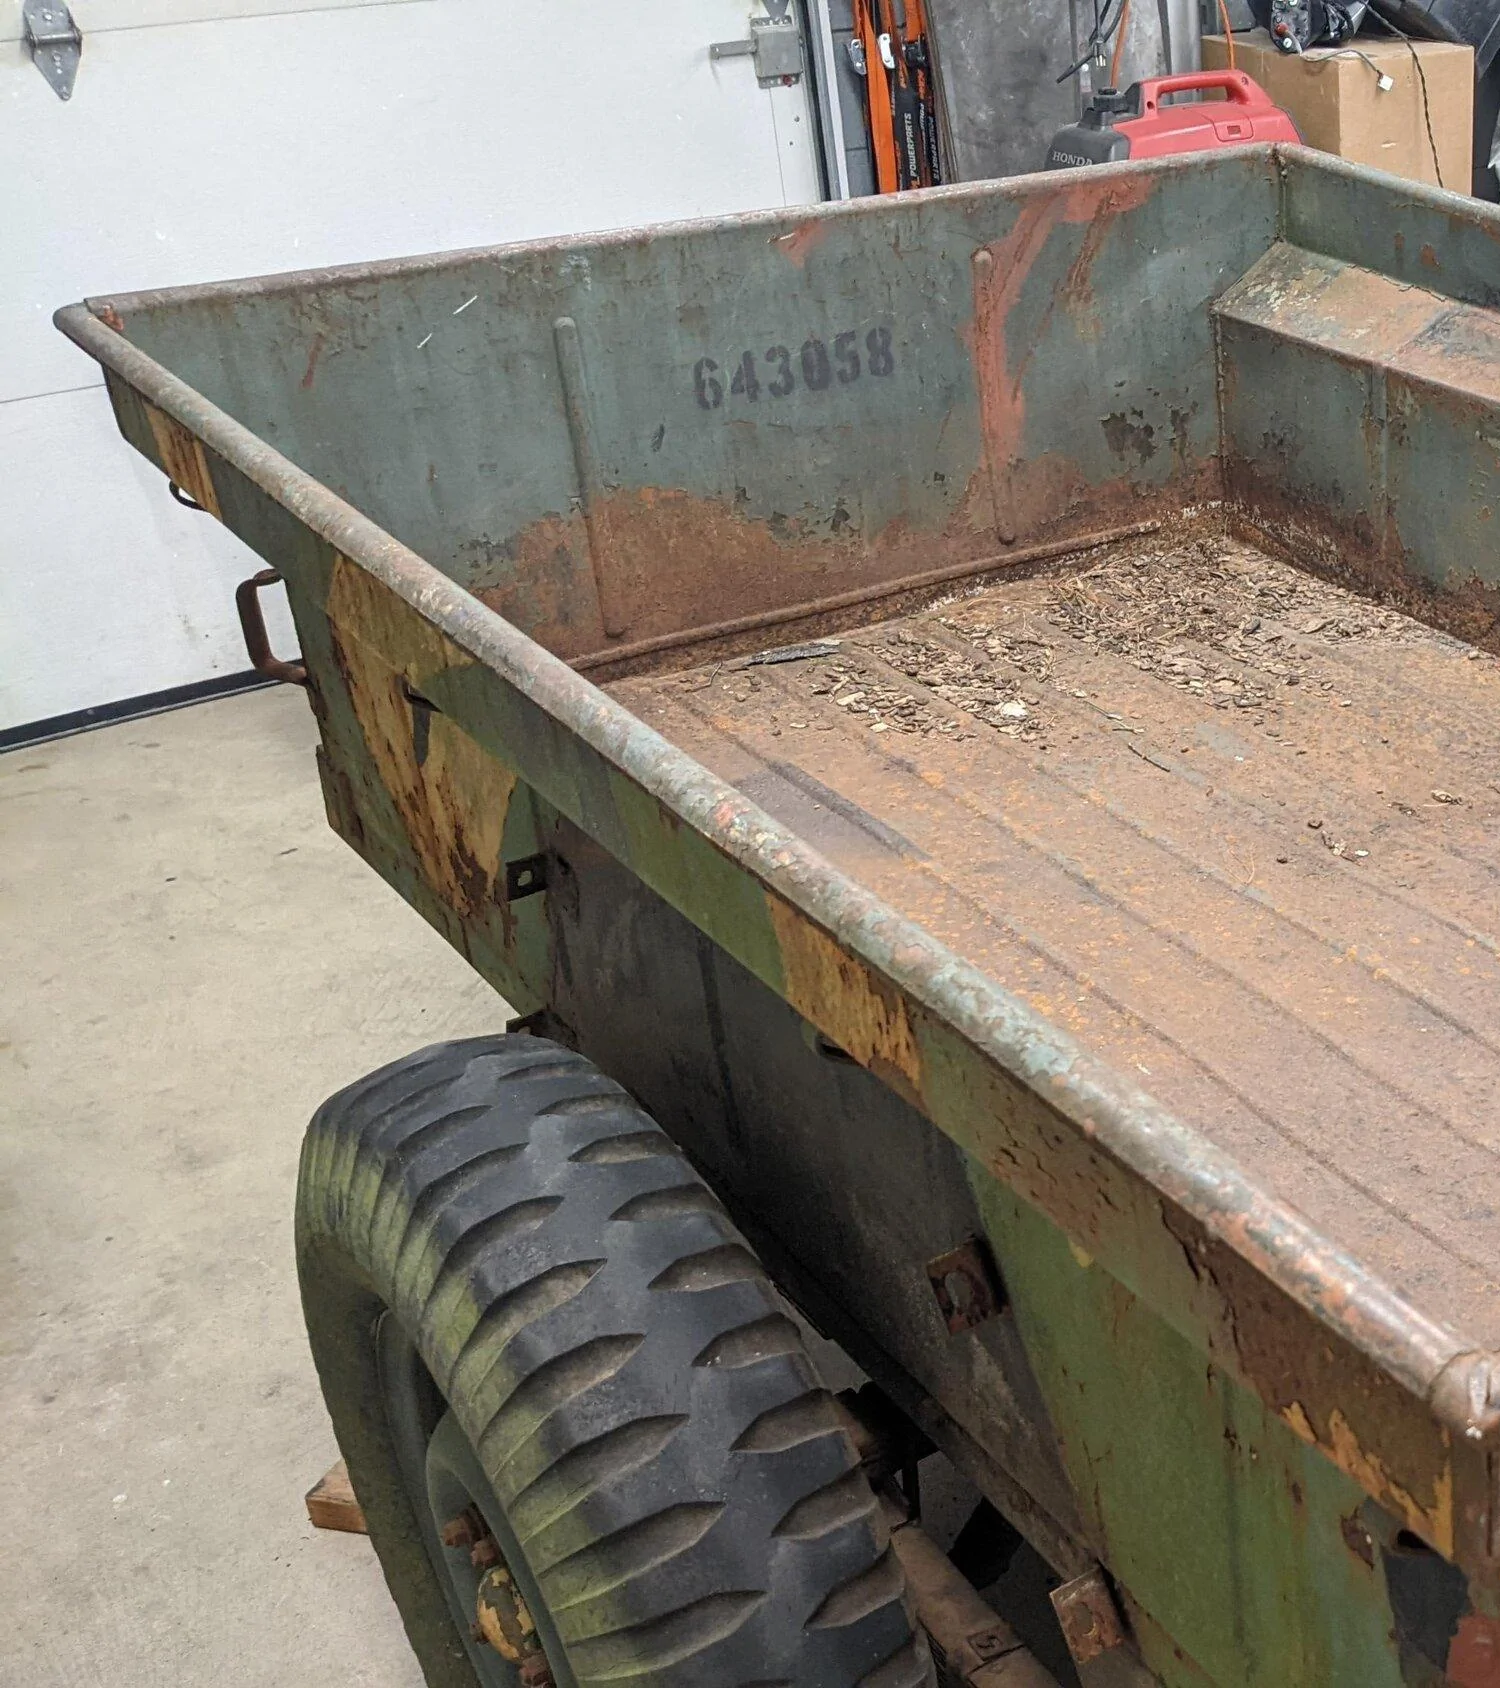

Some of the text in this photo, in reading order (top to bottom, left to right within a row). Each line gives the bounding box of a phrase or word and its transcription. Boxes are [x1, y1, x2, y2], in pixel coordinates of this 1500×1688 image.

[904, 112, 917, 178] POWERPARTS
[1052, 151, 1093, 167] HONDA
[693, 326, 895, 411] 643058
